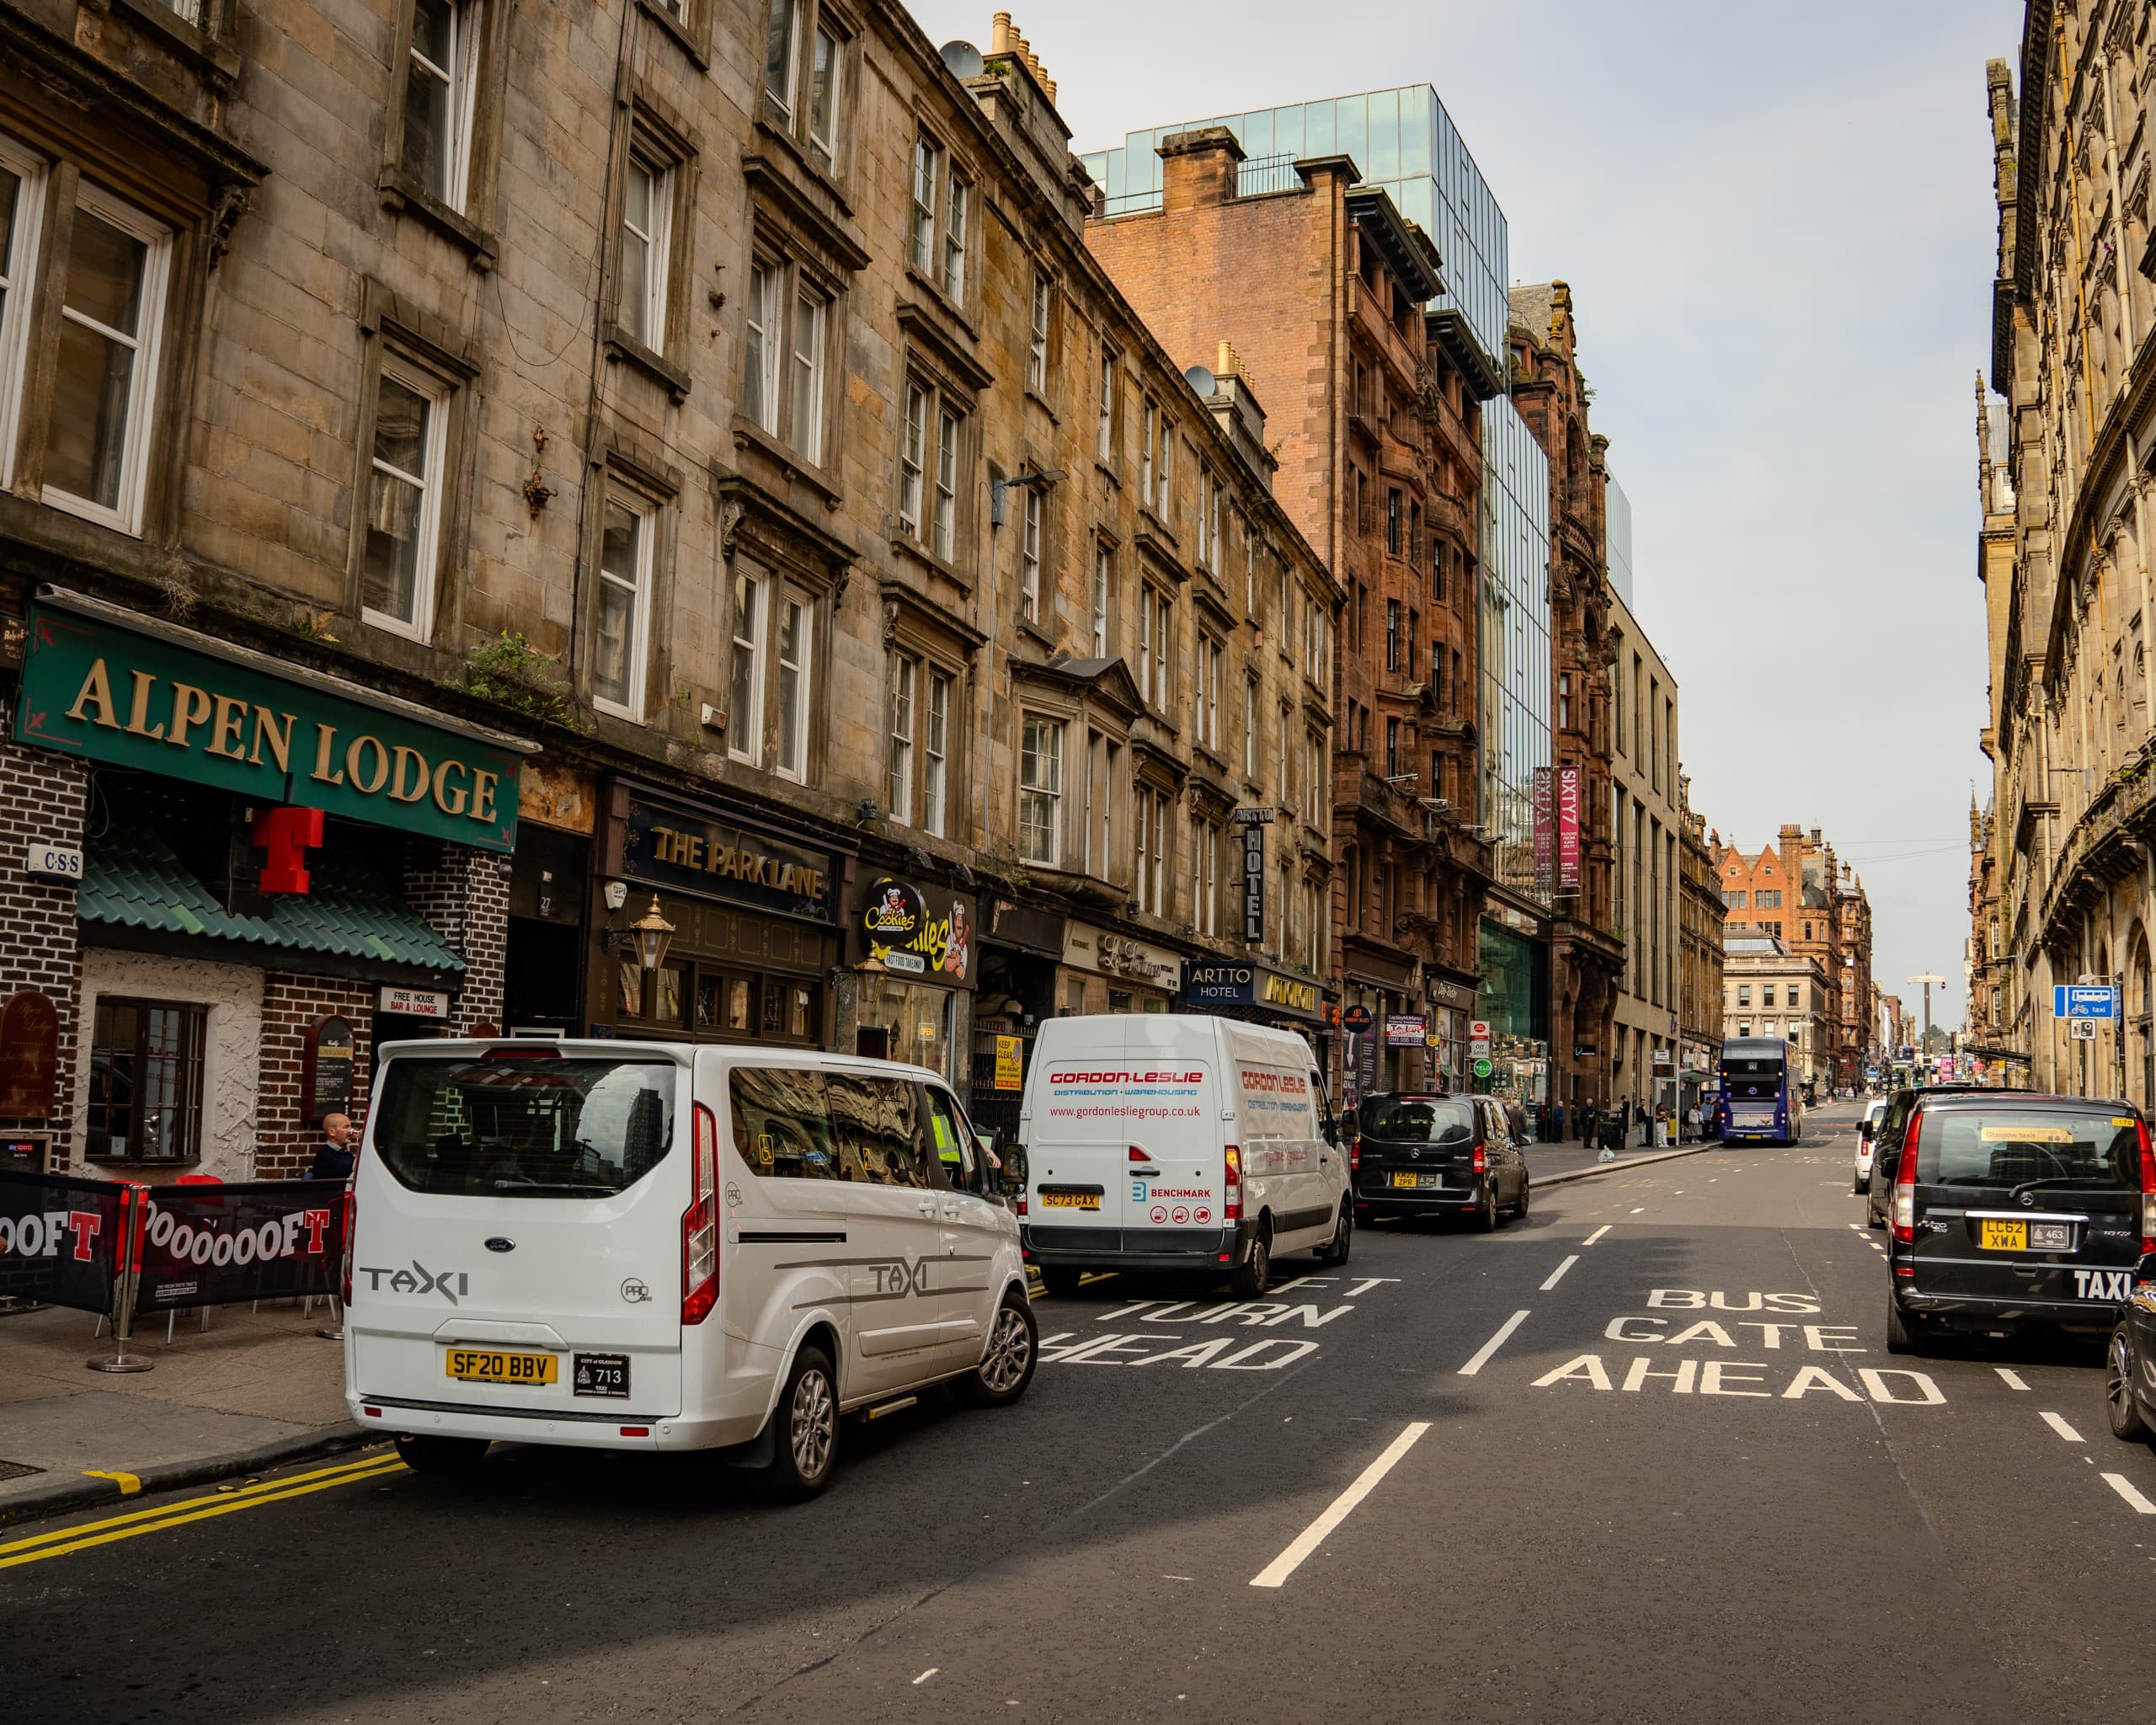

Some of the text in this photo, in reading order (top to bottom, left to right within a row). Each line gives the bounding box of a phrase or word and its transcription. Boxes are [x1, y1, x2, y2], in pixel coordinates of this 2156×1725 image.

[64, 658, 499, 824] ALPEN LODGE
[1561, 770, 1577, 825] SIXTY7
[1235, 808, 1273, 823] ARTTO
[653, 825, 824, 900] THE PARK LANE
[1246, 830, 1261, 939] HOTEL
[540, 896, 552, 909] 27
[864, 908, 915, 931] Cookies
[886, 953, 925, 969] FAST FOOD TAKEAWAY
[1192, 969, 1251, 984] ARTTO
[394, 991, 435, 1004] FREE HOUSE
[1200, 987, 1240, 998] HOTEL
[391, 1001, 438, 1014] BAR & LOUNGE
[921, 1028, 933, 1036] OPEN
[998, 1040, 1011, 1049] KEEP
[997, 1050, 1015, 1060] CLEAR
[1241, 1071, 1278, 1092] GORDON
[1050, 1105, 1201, 1119] www.gordonlesliegroup.co.uk
[1986, 1131, 2017, 1140] Glasgow
[1047, 1194, 1095, 1206] SC73 GAX
[1151, 1188, 1211, 1198] BENCHMARK
[1987, 1220, 2023, 1234] LC62
[2047, 1230, 2063, 1239] 463
[1991, 1235, 2018, 1247] XWA
[359, 1259, 468, 1306] TAXI
[869, 1261, 926, 1295] TAXI
[2073, 1269, 2132, 1300] TAXI
[1646, 1288, 1822, 1313] BUS
[1096, 1300, 1355, 1327] TURN
[1604, 1316, 1868, 1352] GATE
[1037, 1332, 1320, 1370] HEAD
[454, 1353, 547, 1379] SF20 BBV
[595, 1369, 622, 1384] 713
[1529, 1354, 1948, 1405] AHEAD
